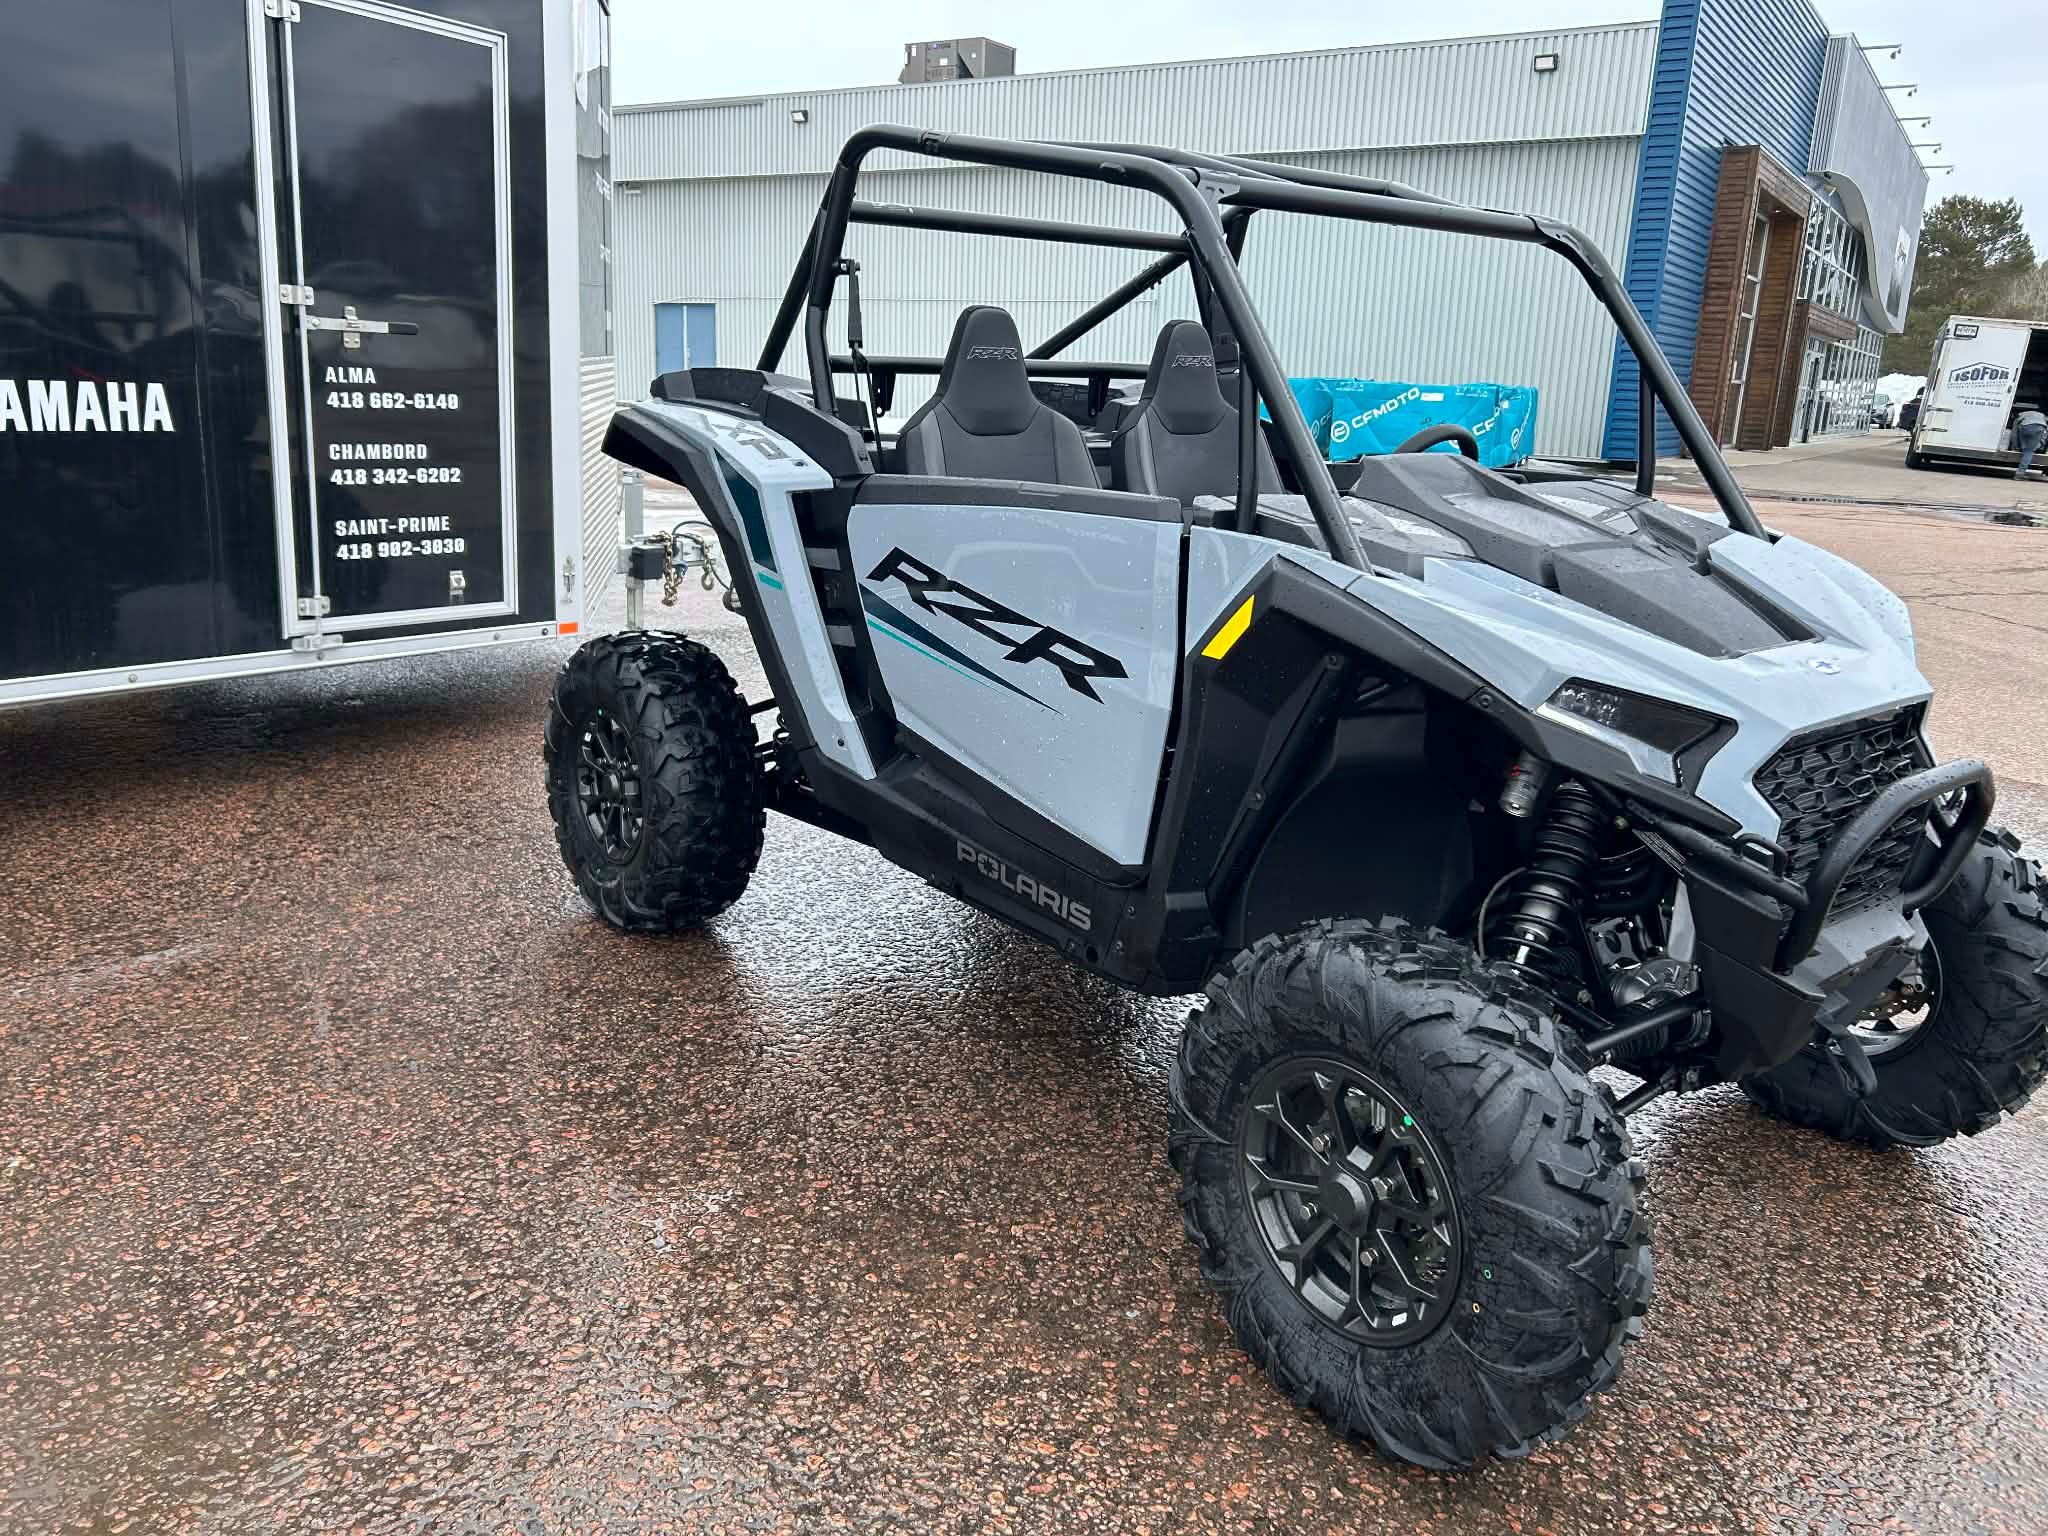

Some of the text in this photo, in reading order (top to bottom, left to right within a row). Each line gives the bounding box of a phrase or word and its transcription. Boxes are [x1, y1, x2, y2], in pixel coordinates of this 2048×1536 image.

[967, 345, 1017, 360] RZR
[1172, 354, 1213, 368] RZR
[325, 366, 377, 384] ALMA
[0, 379, 176, 432] AMAHA
[326, 391, 459, 410] 418 662-6140
[1351, 386, 1420, 429] CFMOTO
[329, 443, 428, 460] CHAMBORD
[330, 467, 461, 485] 418 342-6202
[335, 516, 450, 537] SAINT-PRIME
[336, 537, 465, 560] 418 902-3030
[865, 546, 1129, 705] RZR
[956, 839, 1092, 931] POLARIS
